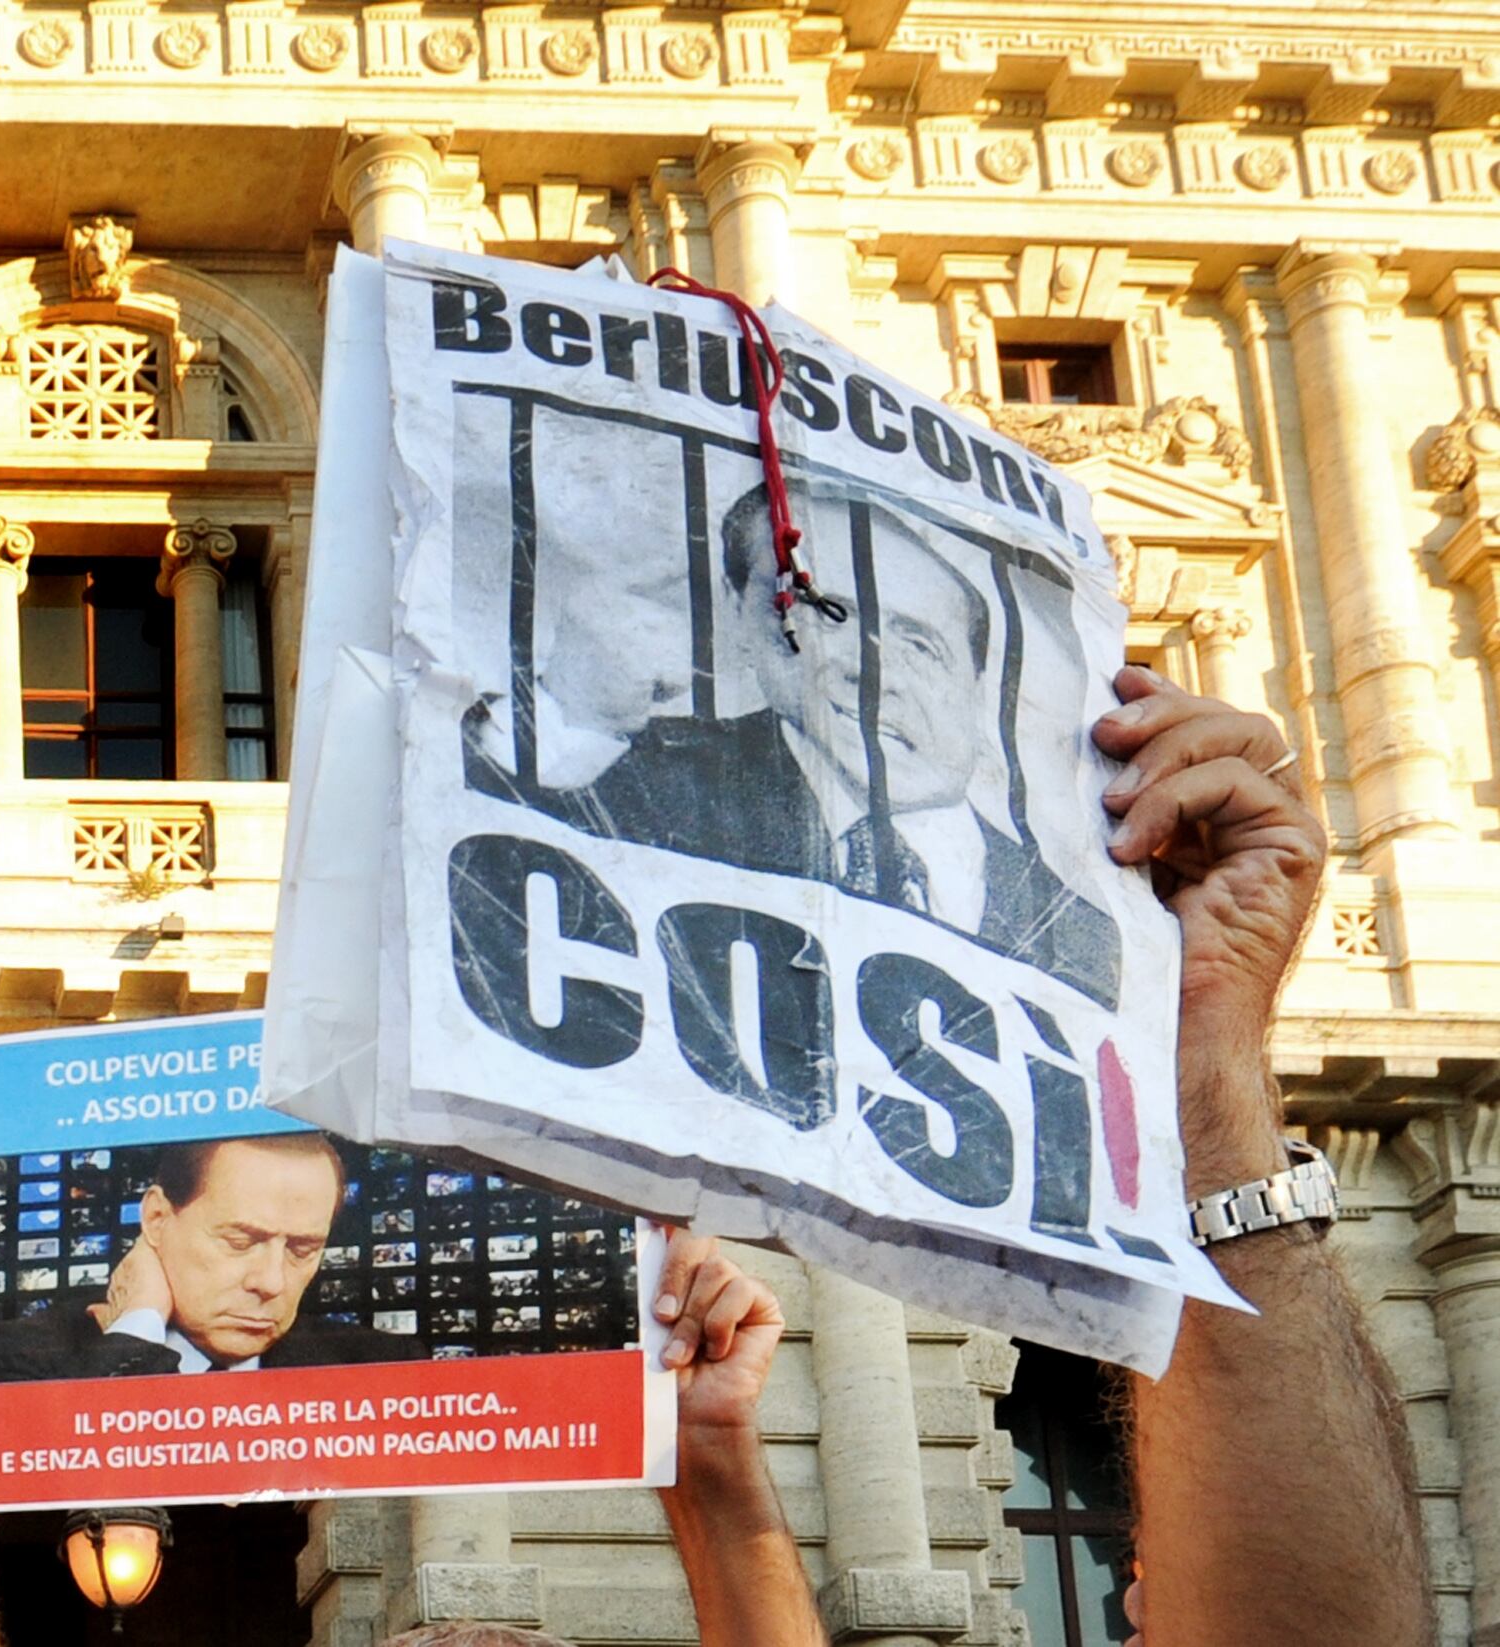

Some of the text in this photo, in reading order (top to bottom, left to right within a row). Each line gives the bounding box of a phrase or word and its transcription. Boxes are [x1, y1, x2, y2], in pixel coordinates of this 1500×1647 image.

[45, 1047, 217, 1086] COLPEVOLE
[82, 1090, 216, 1124] ASSOLTO
[74, 1392, 517, 1435] IL POPOLO PAGA PER LA POLITICA..
[1, 1452, 15, 1473] E
[20, 1447, 100, 1473] SENZA
[106, 1441, 230, 1468] GIUSTIZIA
[237, 1437, 307, 1462] LORO
[314, 1434, 375, 1458] NON
[383, 1428, 497, 1455] PAGANO
[504, 1425, 560, 1450] MAI
